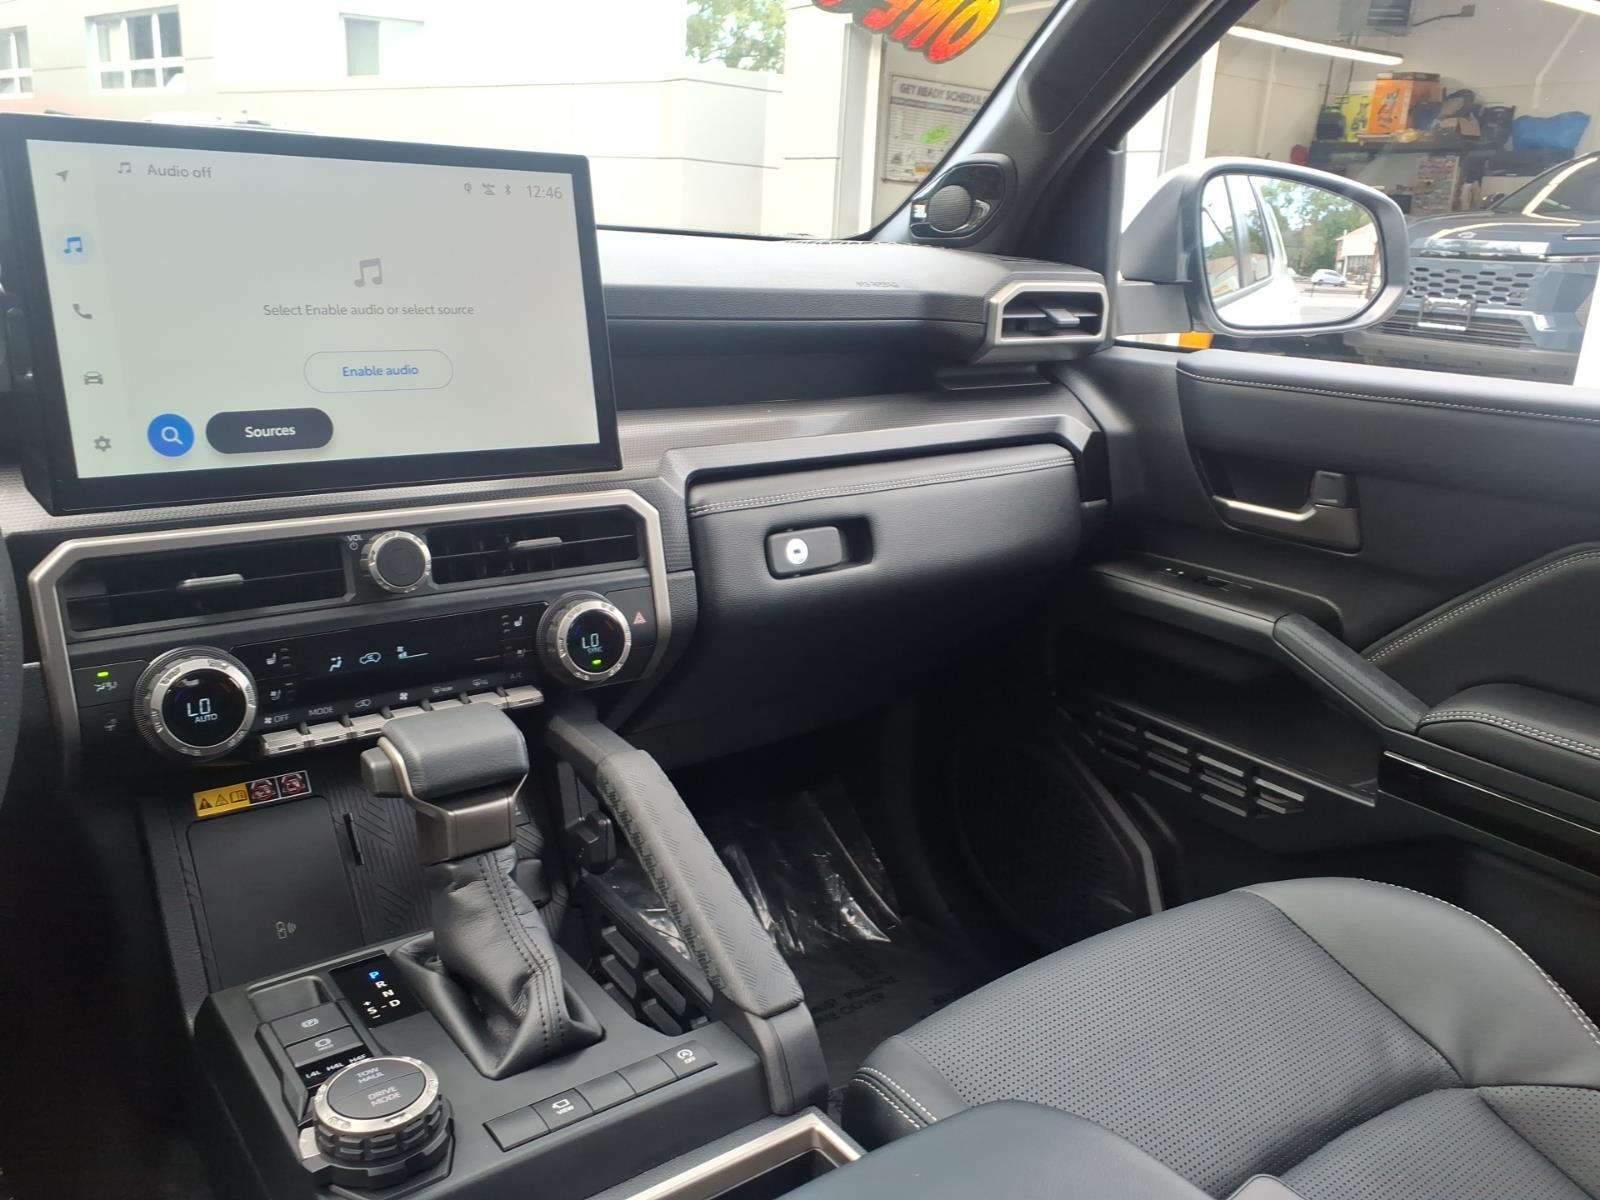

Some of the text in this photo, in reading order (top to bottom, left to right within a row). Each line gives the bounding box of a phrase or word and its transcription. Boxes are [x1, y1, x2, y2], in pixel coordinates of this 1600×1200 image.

[900, 83, 917, 95] GET
[917, 85, 945, 99] READY
[147, 164, 213, 179] Audio off
[526, 184, 563, 200] 12:46
[263, 304, 474, 316] Select Enable audio or select source
[342, 364, 419, 377] Enable audio
[244, 426, 296, 438] Sources
[581, 632, 600, 649] LO
[186, 697, 212, 717] LO
[308, 705, 334, 716] MODE
[194, 713, 218, 724] AUTO
[273, 714, 291, 723] OFF
[369, 970, 380, 979] P
[375, 980, 388, 988] R
[382, 989, 395, 998] N
[388, 999, 401, 1008] D
[367, 1006, 378, 1015] S
[356, 1066, 380, 1078] TOW
[358, 1071, 385, 1084] HAUL
[367, 1085, 398, 1101] DRIVE
[370, 1091, 402, 1107] MODE
